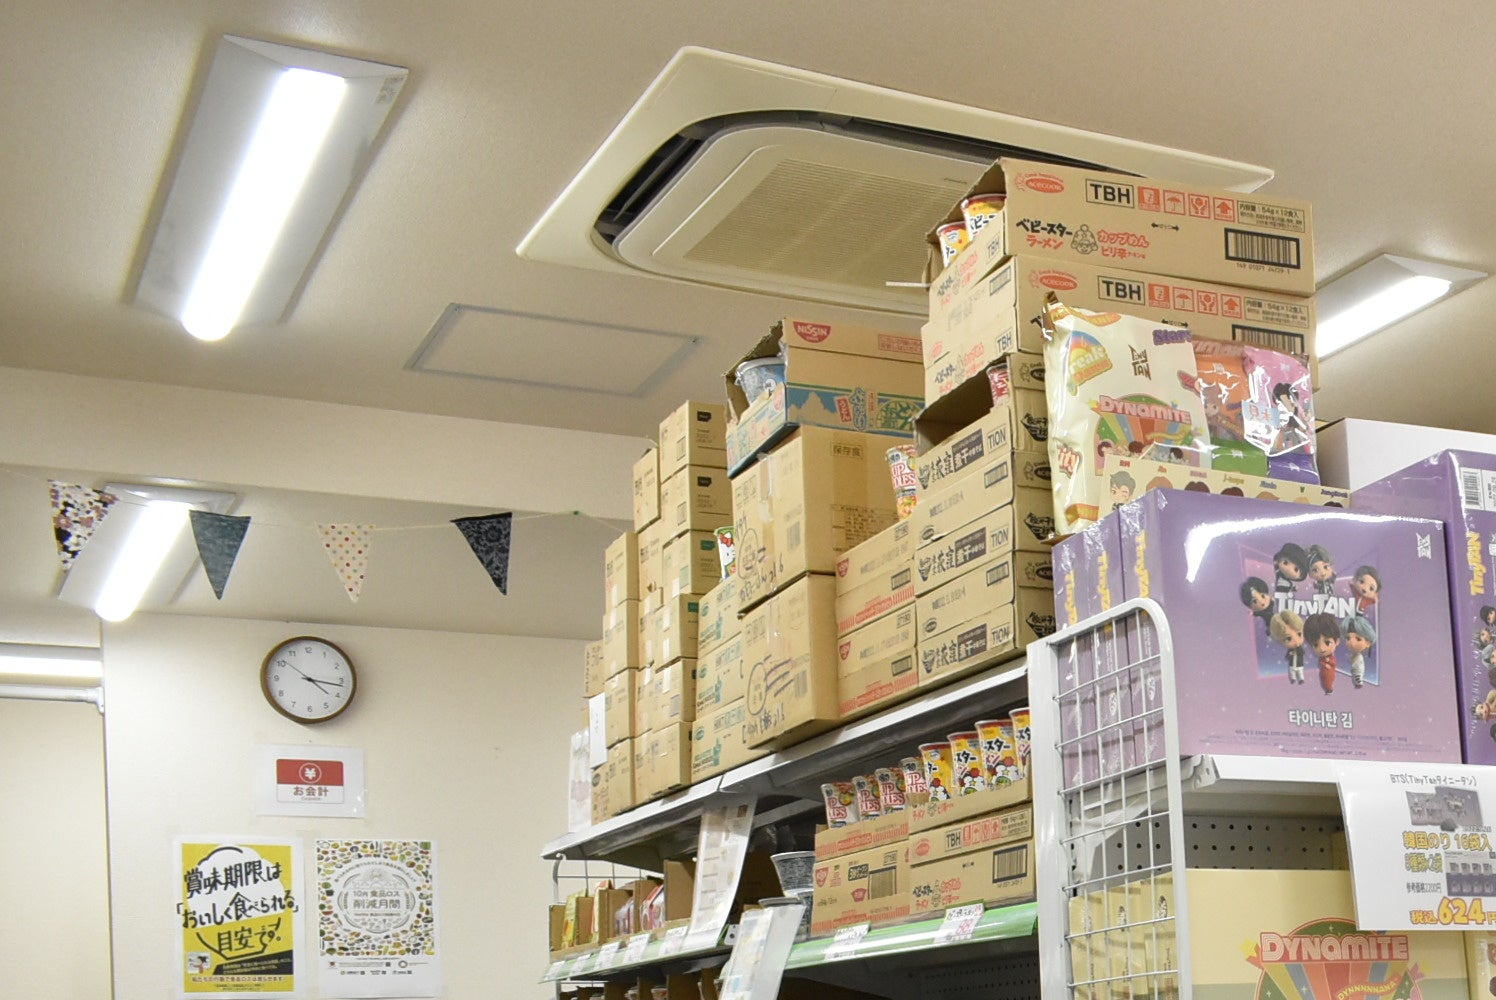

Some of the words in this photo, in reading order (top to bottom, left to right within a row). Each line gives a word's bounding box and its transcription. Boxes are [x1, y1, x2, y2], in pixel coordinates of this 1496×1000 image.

[1089, 183, 1131, 204] TBH
[1016, 218, 1073, 238] ベビースター
[1026, 234, 1064, 250] ラーメン
[1097, 229, 1150, 248] カップめん
[1102, 281, 1143, 301] TBH
[797, 324, 829, 338] NISSIN
[997, 332, 1013, 353] TBH
[304, 646, 313, 654] 12
[277, 660, 286, 668] 10
[1288, 709, 1340, 728] 타이니탄
[1341, 711, 1354, 729] 김
[292, 785, 329, 798] お会計
[946, 832, 961, 849] TBH
[1402, 830, 1450, 851] 韓国のり
[1454, 833, 1494, 852] 16袋入
[183, 861, 283, 895] 賞味期限は
[176, 889, 300, 929] 「おいしく食べられる」
[353, 899, 401, 910] 削減月間
[216, 916, 282, 953] 目安です。
[1259, 931, 1410, 963] DYNAMITE
